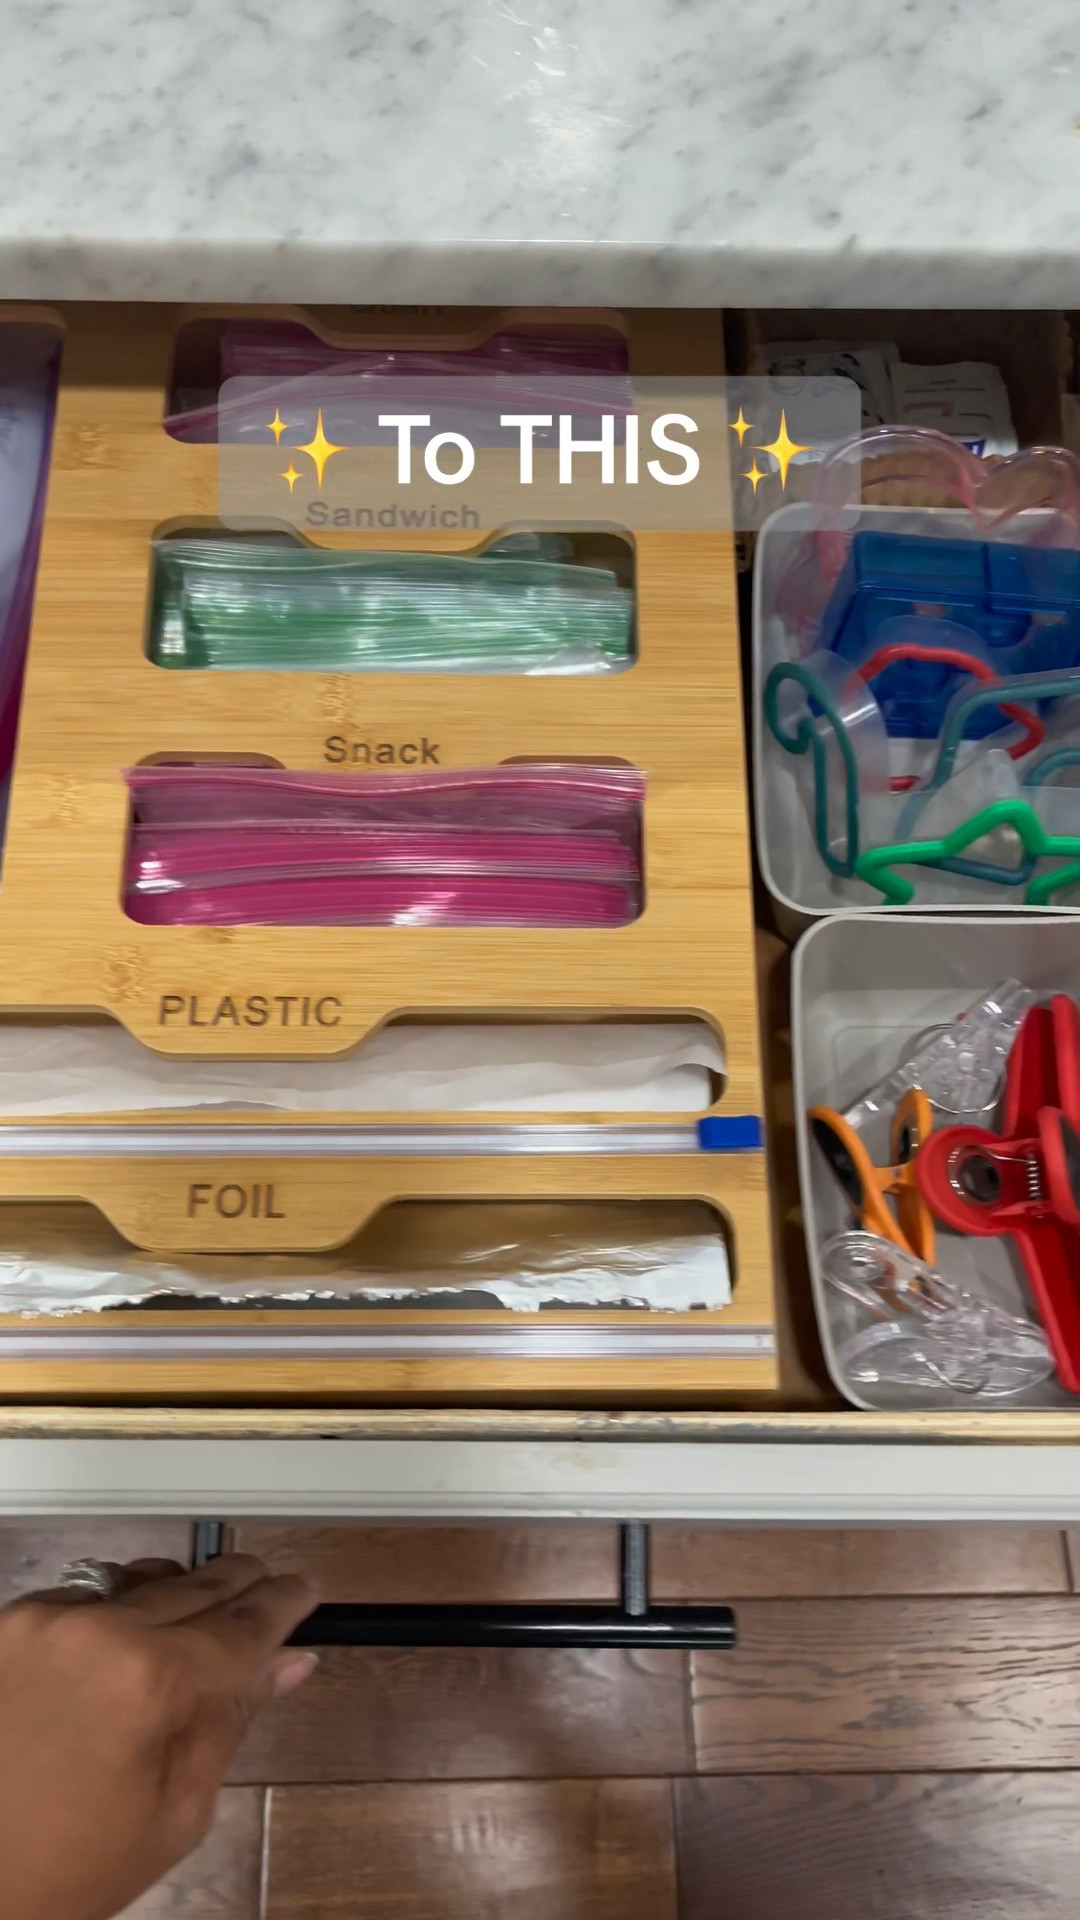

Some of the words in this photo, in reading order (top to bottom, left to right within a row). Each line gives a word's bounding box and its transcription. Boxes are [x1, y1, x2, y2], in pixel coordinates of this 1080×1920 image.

[306, 501, 479, 528] Sandwich
[324, 736, 440, 764] Snack
[158, 996, 342, 1027] PLASTIC
[187, 1184, 286, 1219] FOIL
